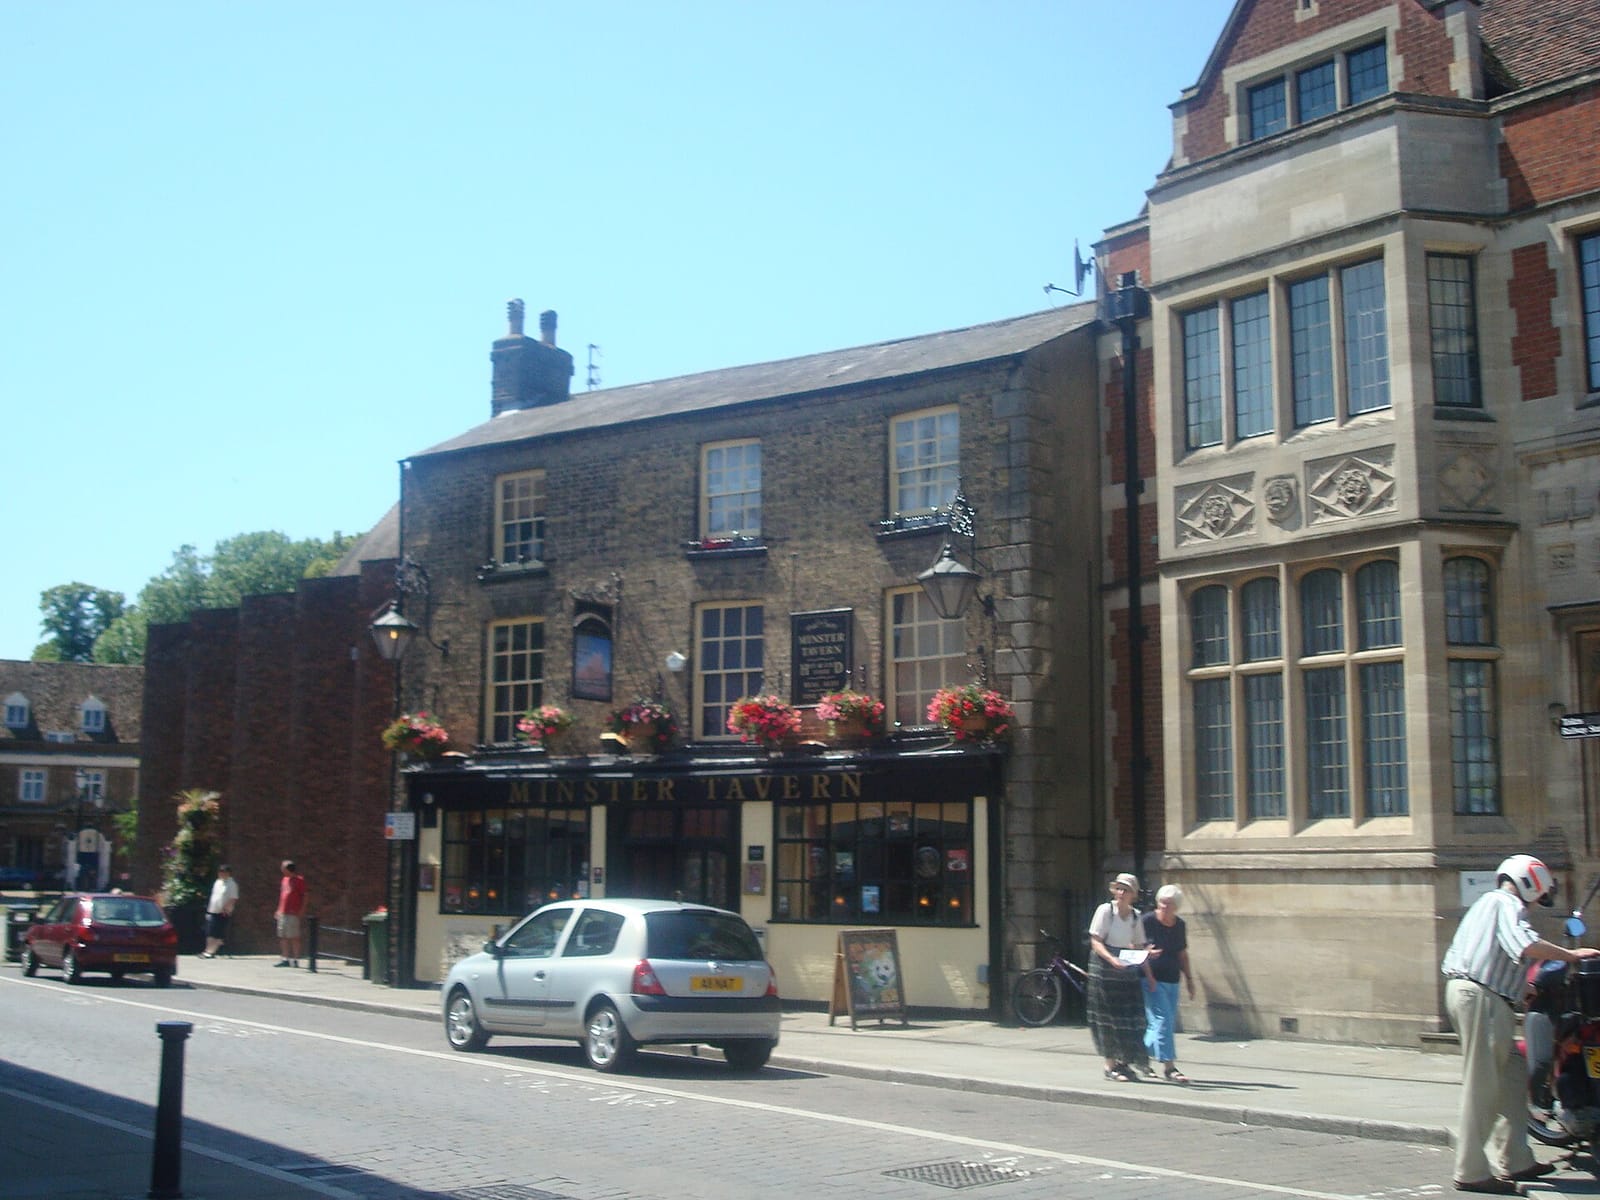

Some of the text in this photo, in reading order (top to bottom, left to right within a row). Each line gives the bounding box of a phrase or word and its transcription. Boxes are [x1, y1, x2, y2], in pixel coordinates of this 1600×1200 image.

[799, 633, 846, 645] MINSTER
[802, 645, 842, 656] TAVERN
[509, 772, 864, 802] MINSTER TAVERN
